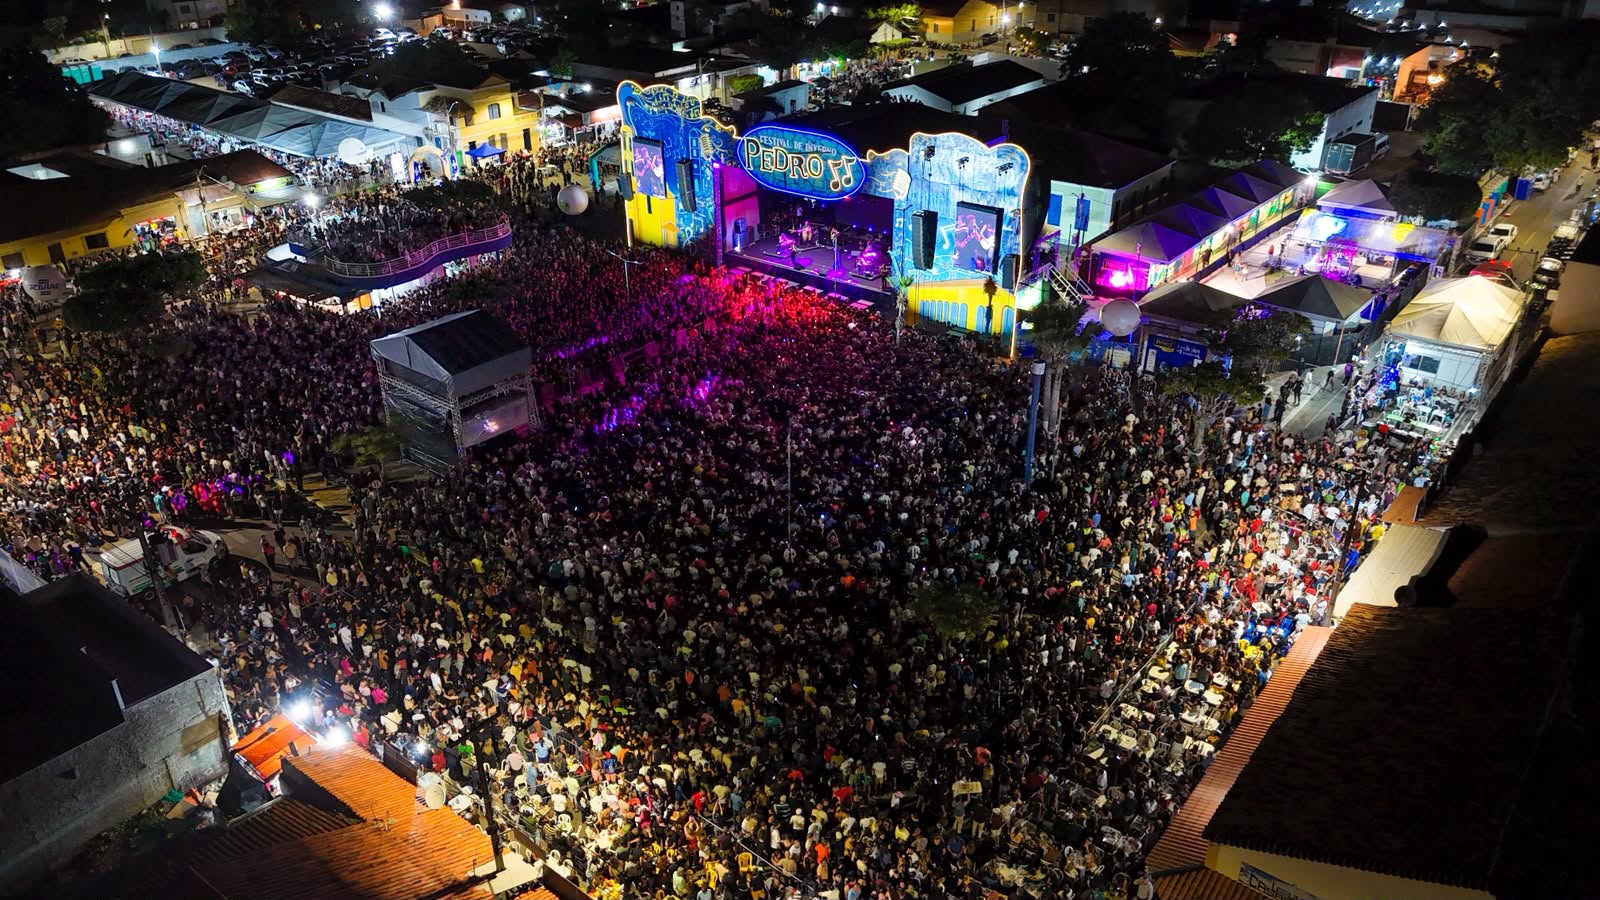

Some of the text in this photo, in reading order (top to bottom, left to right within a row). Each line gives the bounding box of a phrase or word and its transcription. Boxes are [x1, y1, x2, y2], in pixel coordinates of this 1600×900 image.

[744, 137, 824, 179] PEDRO
[759, 135, 837, 157] FESTIVAL DE INVERNO
